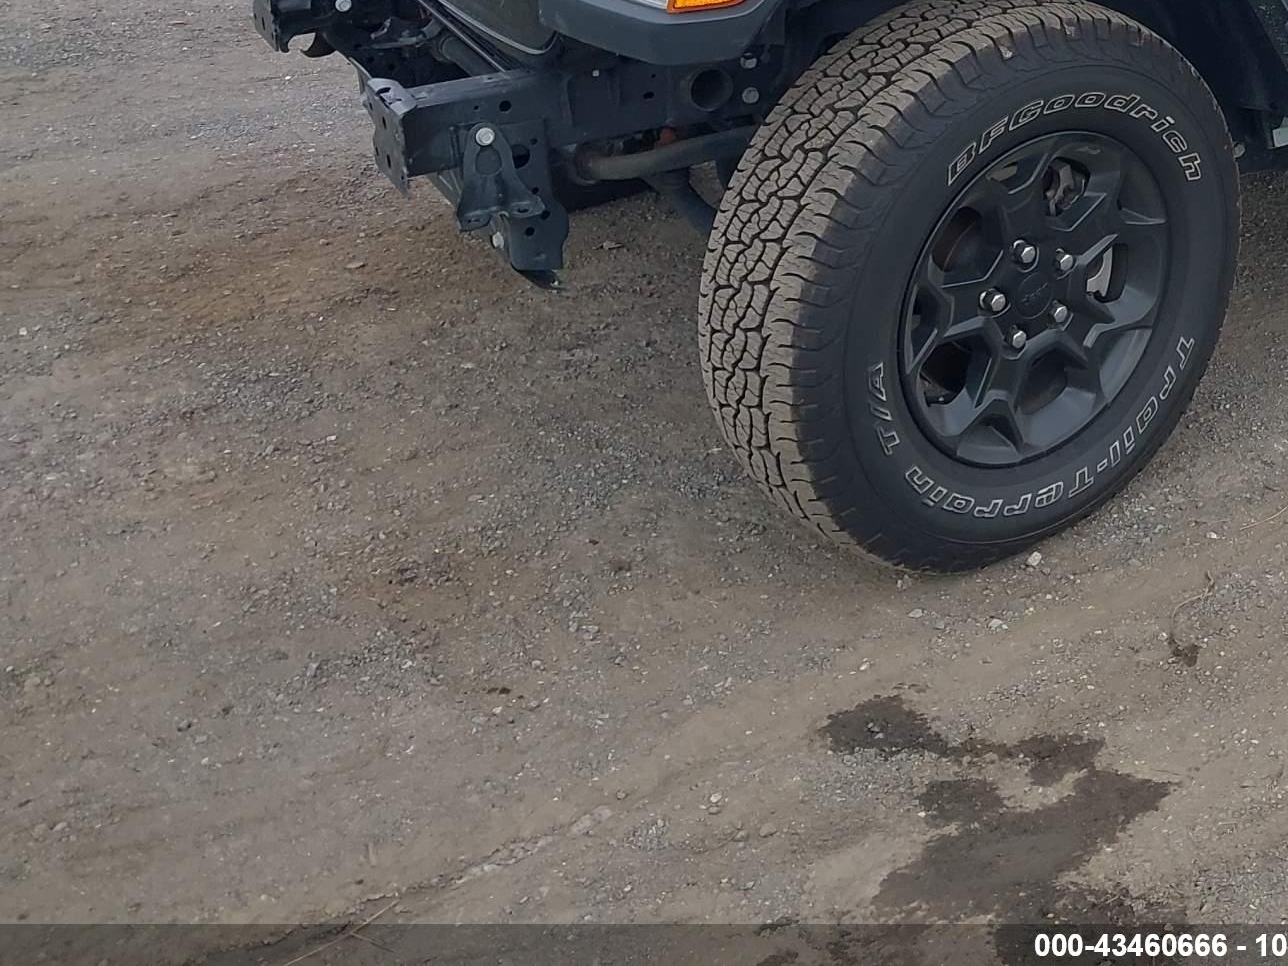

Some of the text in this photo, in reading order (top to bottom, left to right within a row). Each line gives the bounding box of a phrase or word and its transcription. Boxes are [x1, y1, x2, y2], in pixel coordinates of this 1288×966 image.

[947, 91, 1202, 186] BFGoodrich
[868, 336, 1195, 518] Trail-Terrain T/A
